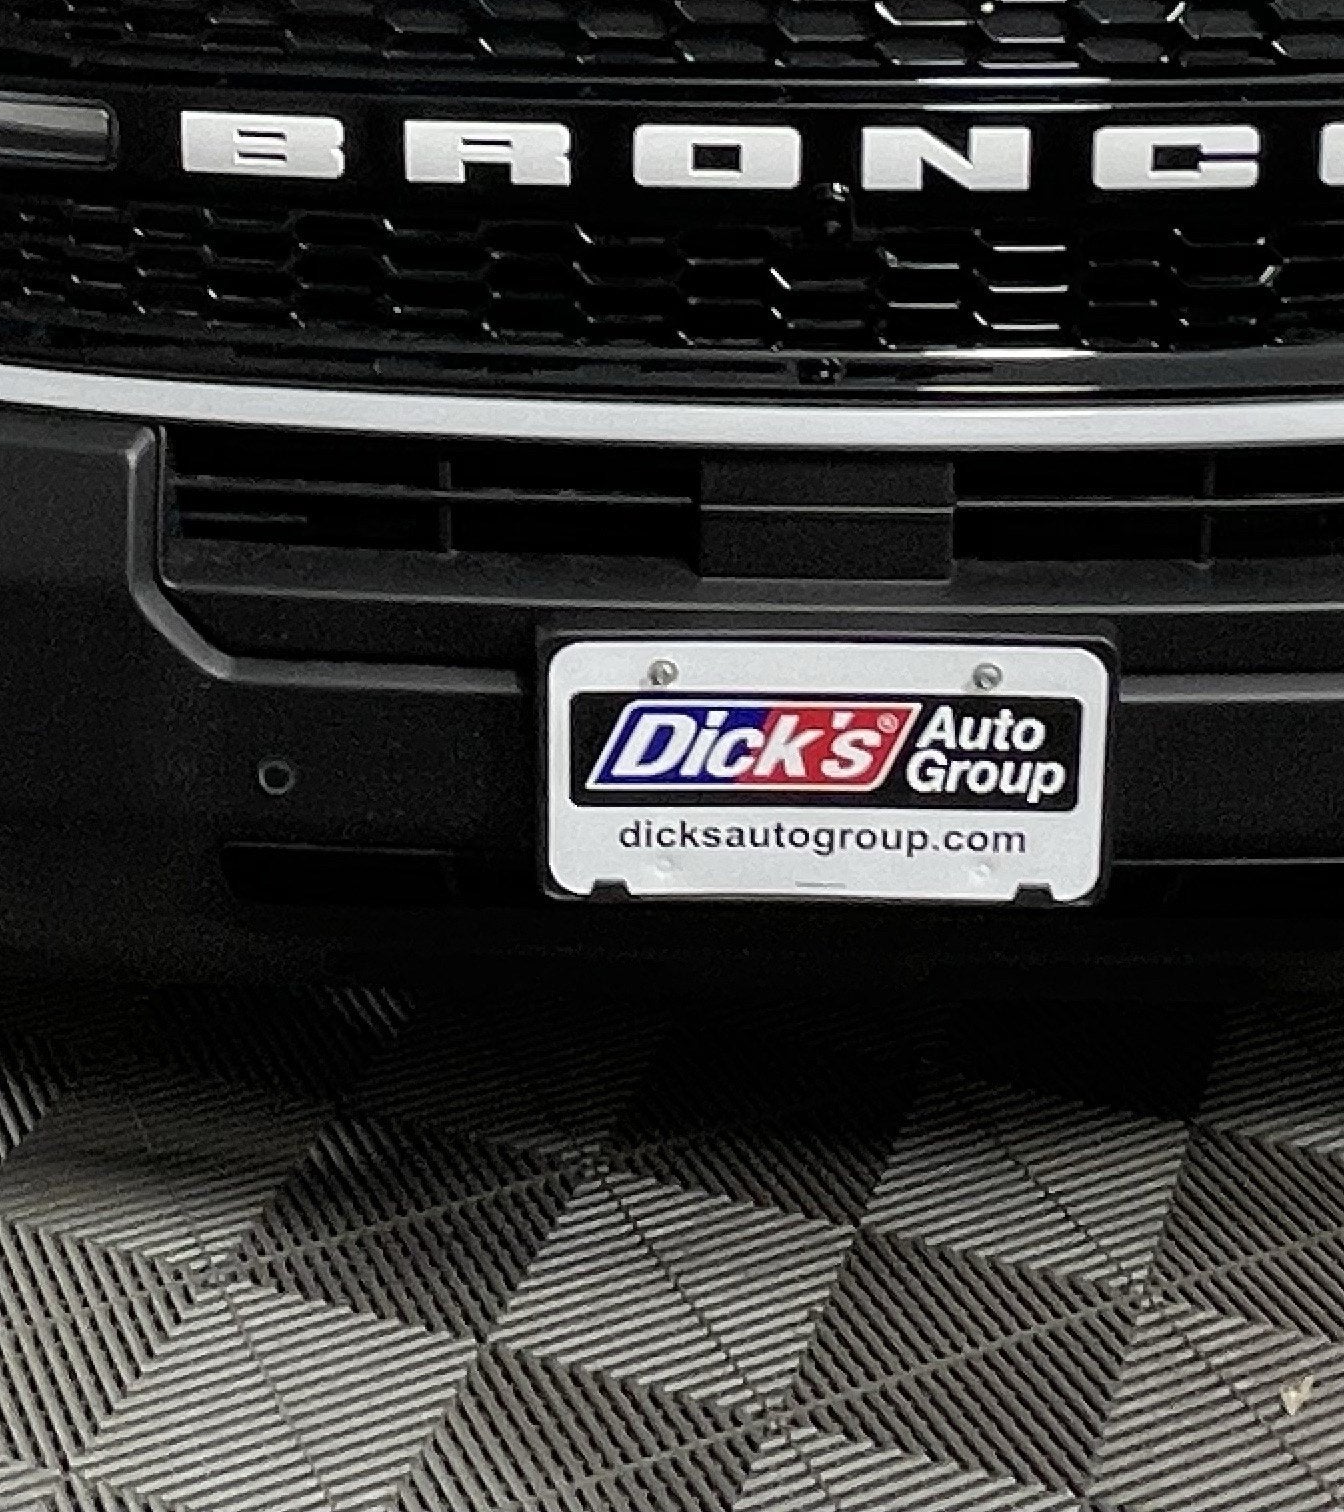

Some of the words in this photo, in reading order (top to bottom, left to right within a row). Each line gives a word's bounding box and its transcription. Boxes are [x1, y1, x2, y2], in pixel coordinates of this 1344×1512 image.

[610, 710, 883, 779] Dick's
[916, 706, 1046, 751] Auto
[905, 751, 1066, 803] Group
[619, 820, 1027, 858] dicksautogroup.com
